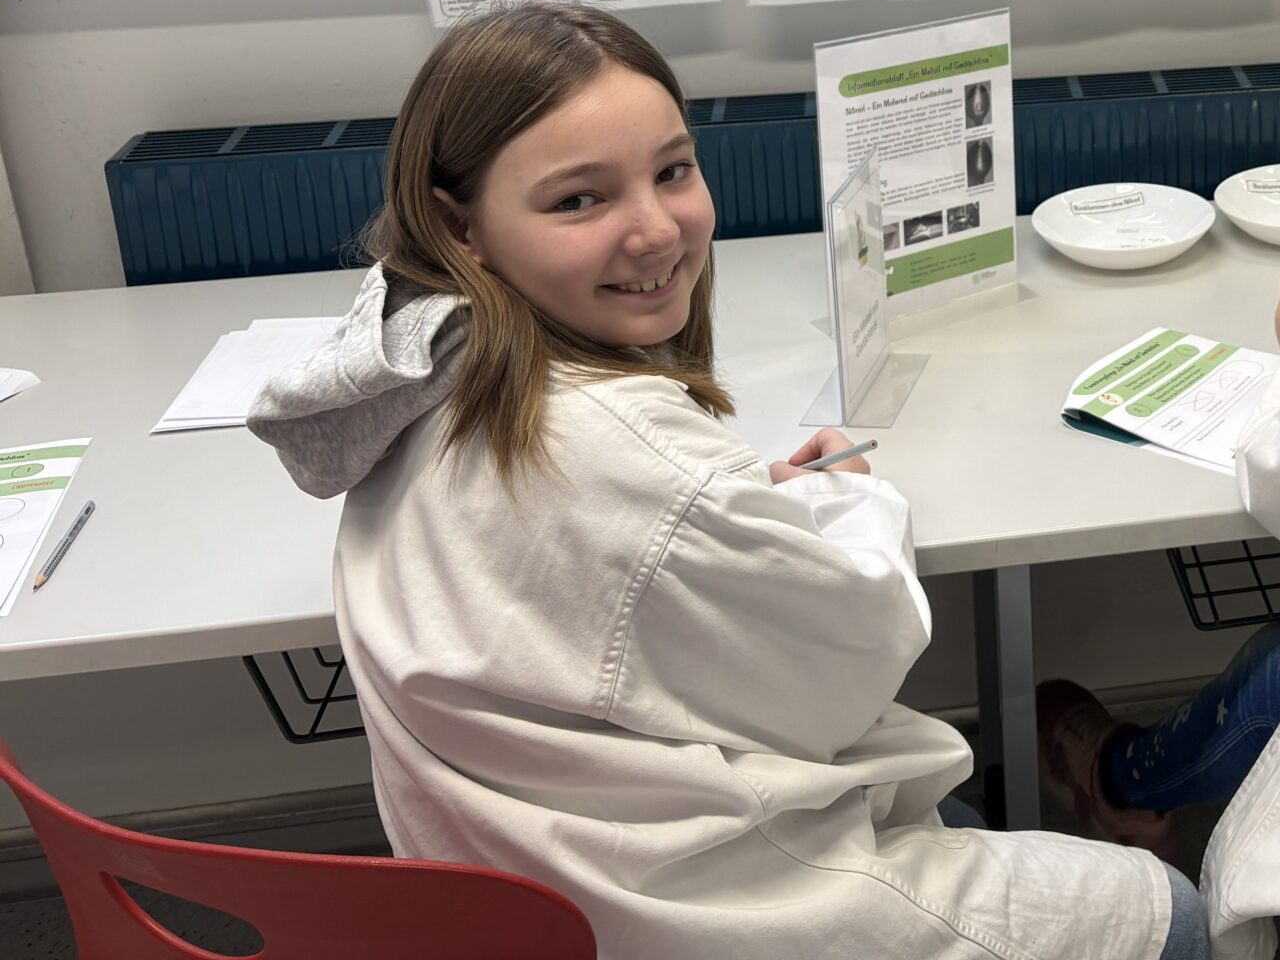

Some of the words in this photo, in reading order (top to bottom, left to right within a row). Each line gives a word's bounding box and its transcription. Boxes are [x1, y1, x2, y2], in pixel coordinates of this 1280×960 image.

[848, 71, 905, 92] Informationsblatt
[921, 66, 941, 77] Metall
[872, 100, 883, 111] Ein
[884, 95, 908, 108] Material
[909, 93, 919, 102] mit
